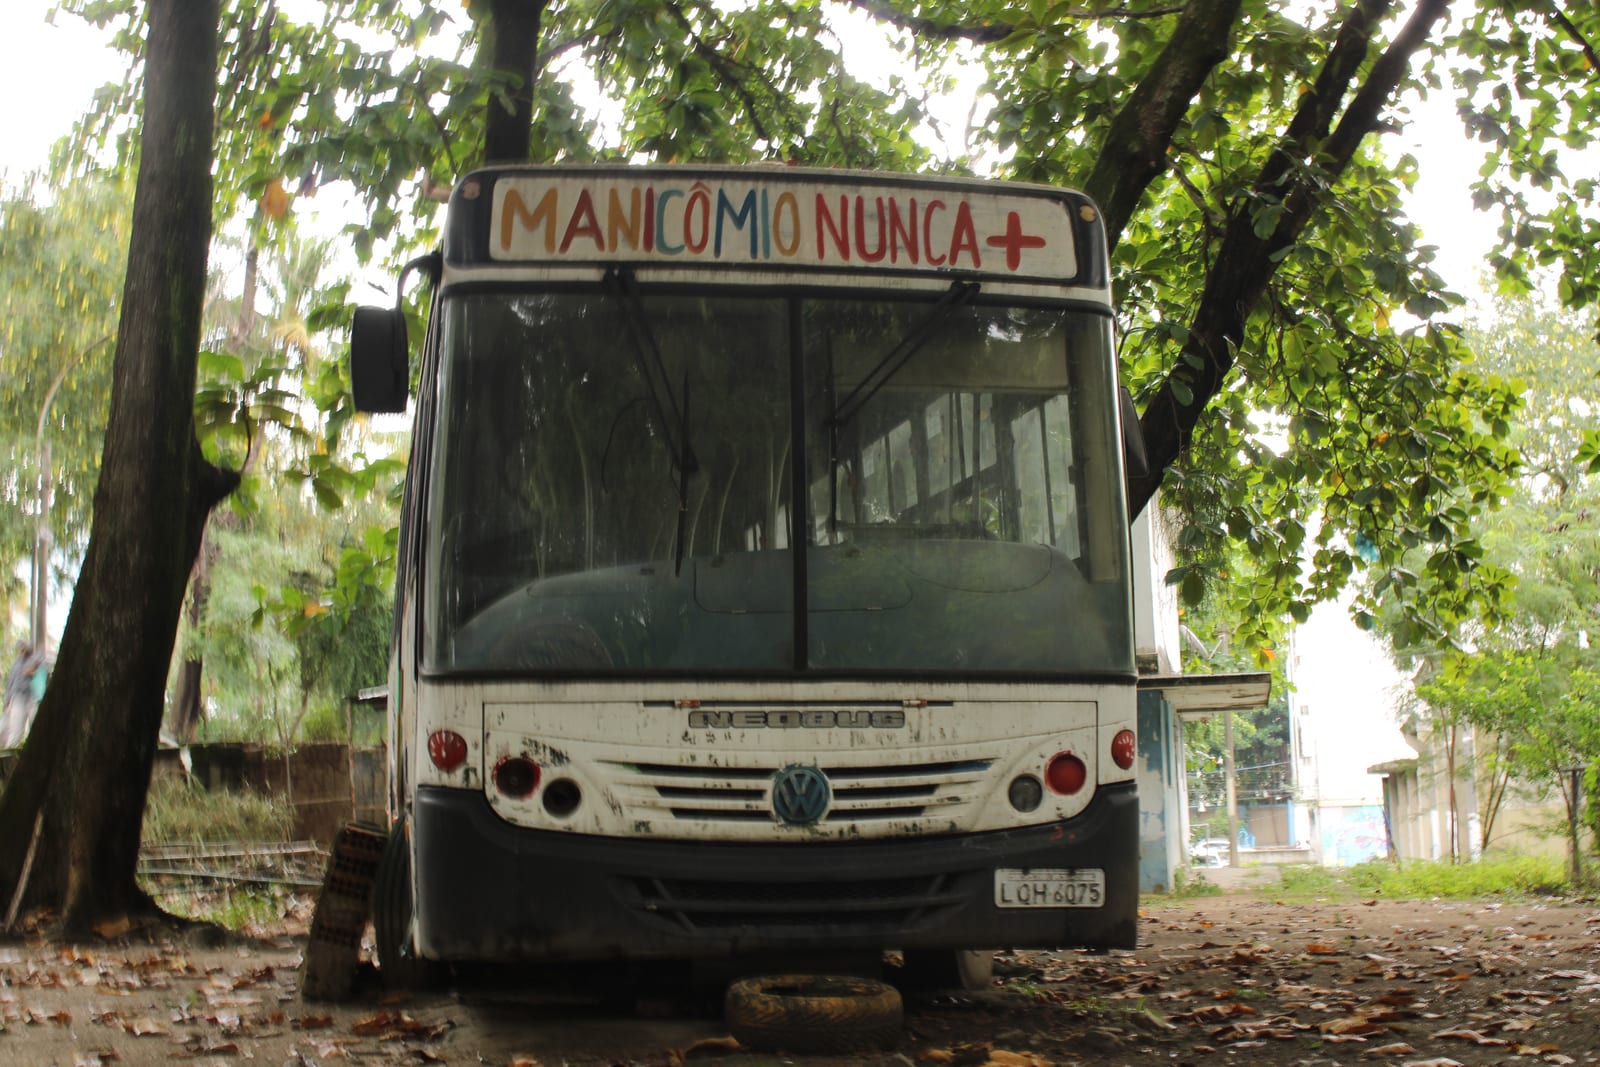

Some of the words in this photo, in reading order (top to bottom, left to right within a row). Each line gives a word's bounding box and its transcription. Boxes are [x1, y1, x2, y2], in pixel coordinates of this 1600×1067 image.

[501, 182, 801, 260] MANICÔMIO
[815, 192, 982, 269] NUNCA
[688, 710, 906, 729] NEOBUS
[775, 769, 830, 823] VW
